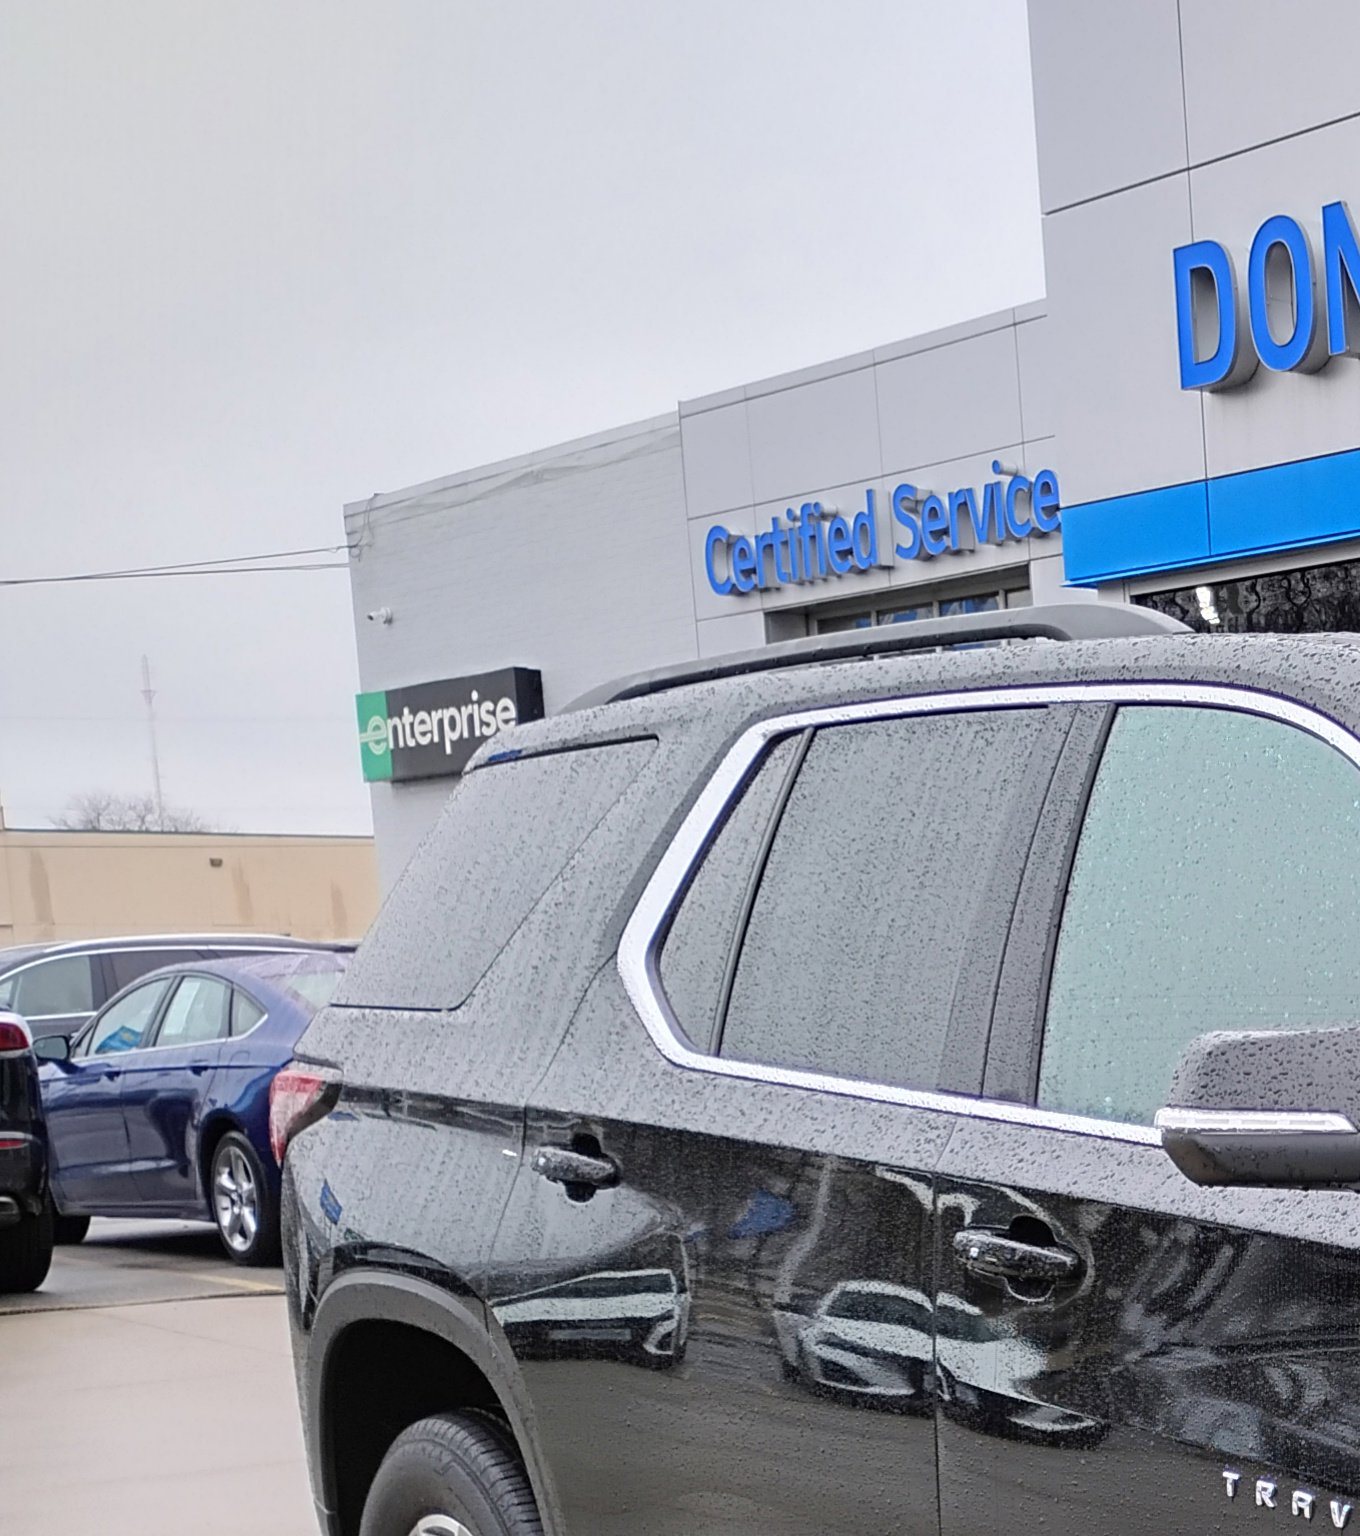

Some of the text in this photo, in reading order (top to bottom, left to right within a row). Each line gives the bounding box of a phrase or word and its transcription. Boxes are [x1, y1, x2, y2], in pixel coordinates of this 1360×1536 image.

[705, 460, 1063, 596] Certified Service
[360, 692, 518, 756] enterprise
